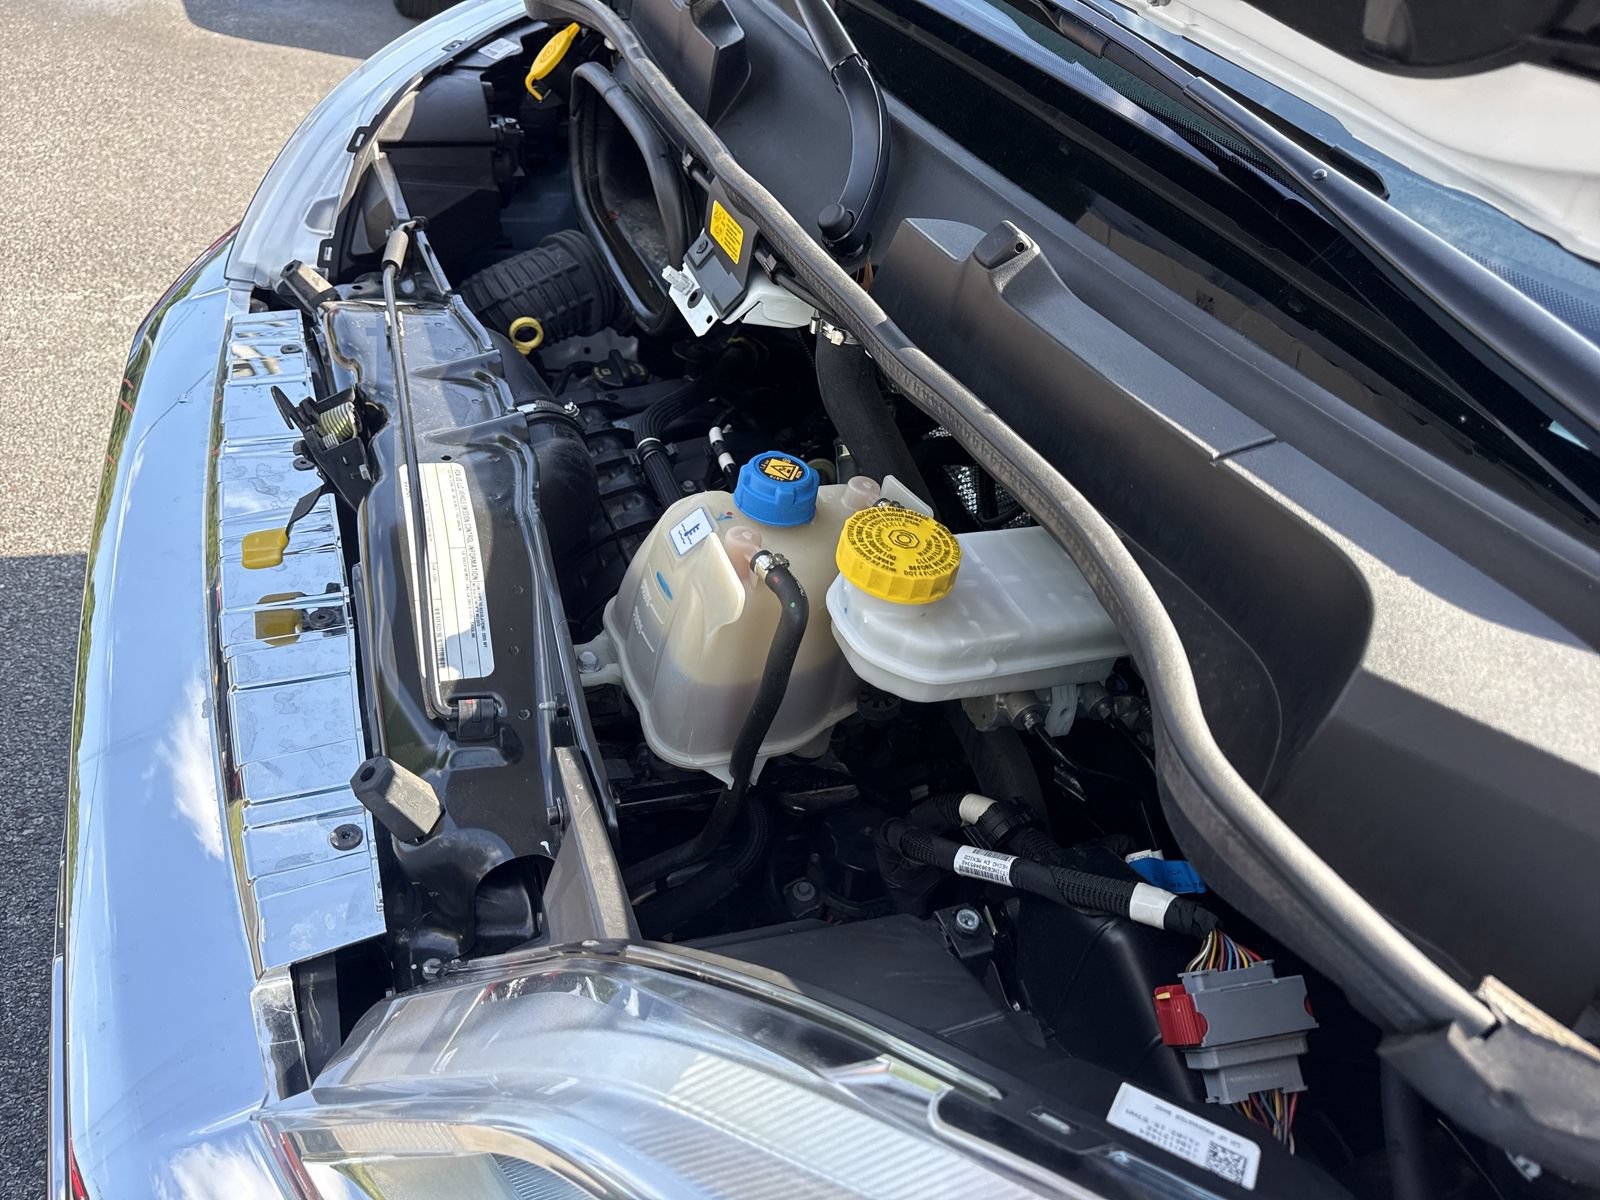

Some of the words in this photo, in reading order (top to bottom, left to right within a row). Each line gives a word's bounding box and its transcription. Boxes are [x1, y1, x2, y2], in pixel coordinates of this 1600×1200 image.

[461, 505, 470, 522] EMISSION
[851, 508, 877, 522] BOUCHON
[885, 507, 931, 521] REMPLISSAGE
[858, 513, 881, 526] UTILISER
[879, 512, 924, 523] UNIQUEMENT
[867, 516, 902, 528] PROVENANT
[464, 523, 474, 543] CONTROL
[864, 529, 873, 538] DOT
[873, 525, 893, 553] CONTENANT
[863, 548, 875, 556] DE
[866, 539, 888, 556] LIQUIDE
[914, 554, 937, 564] CLEAN
[929, 543, 942, 558] FILLER
[469, 545, 478, 580] INFORMATION
[871, 553, 894, 566] AVANT
[907, 562, 934, 570] BEFORE
[921, 567, 942, 576] FLUID
[963, 854, 982, 863] MEXICO
